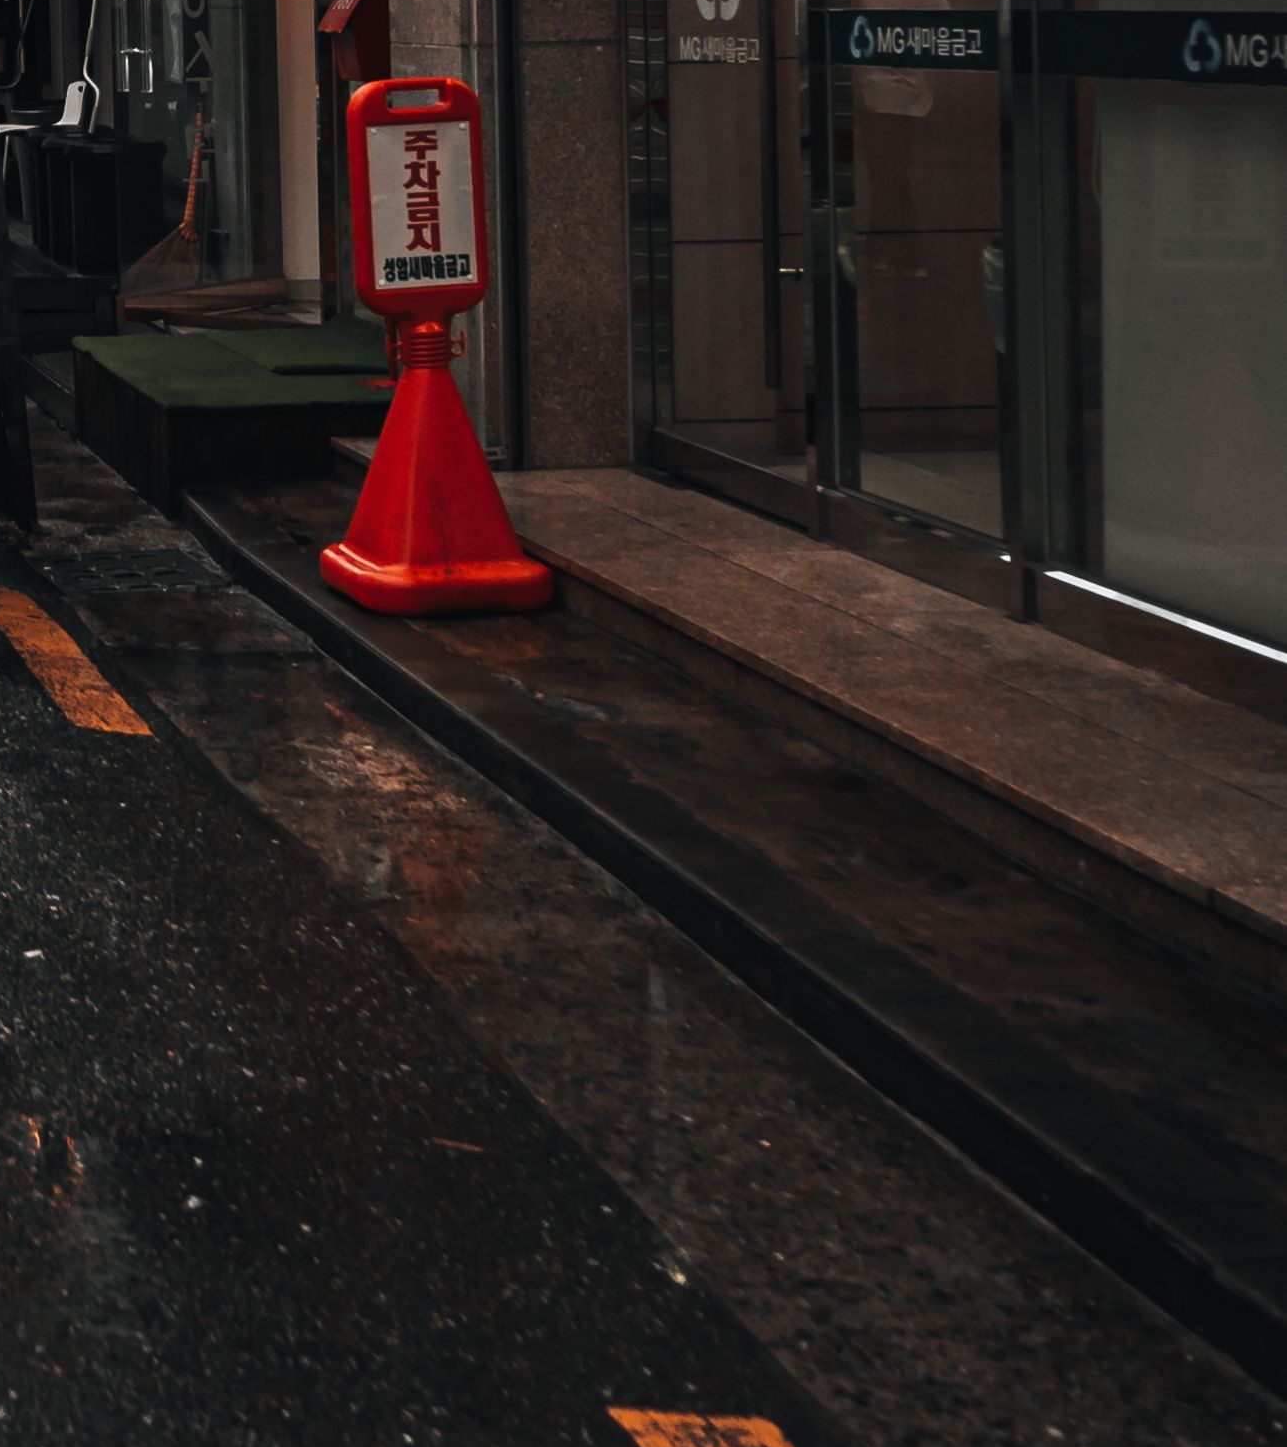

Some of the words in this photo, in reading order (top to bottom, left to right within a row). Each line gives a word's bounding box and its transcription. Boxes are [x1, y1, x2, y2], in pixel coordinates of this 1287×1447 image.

[678, 35, 761, 64] MG새마을금고
[876, 26, 983, 57] MG새마을금고
[402, 129, 442, 253] 주차금지
